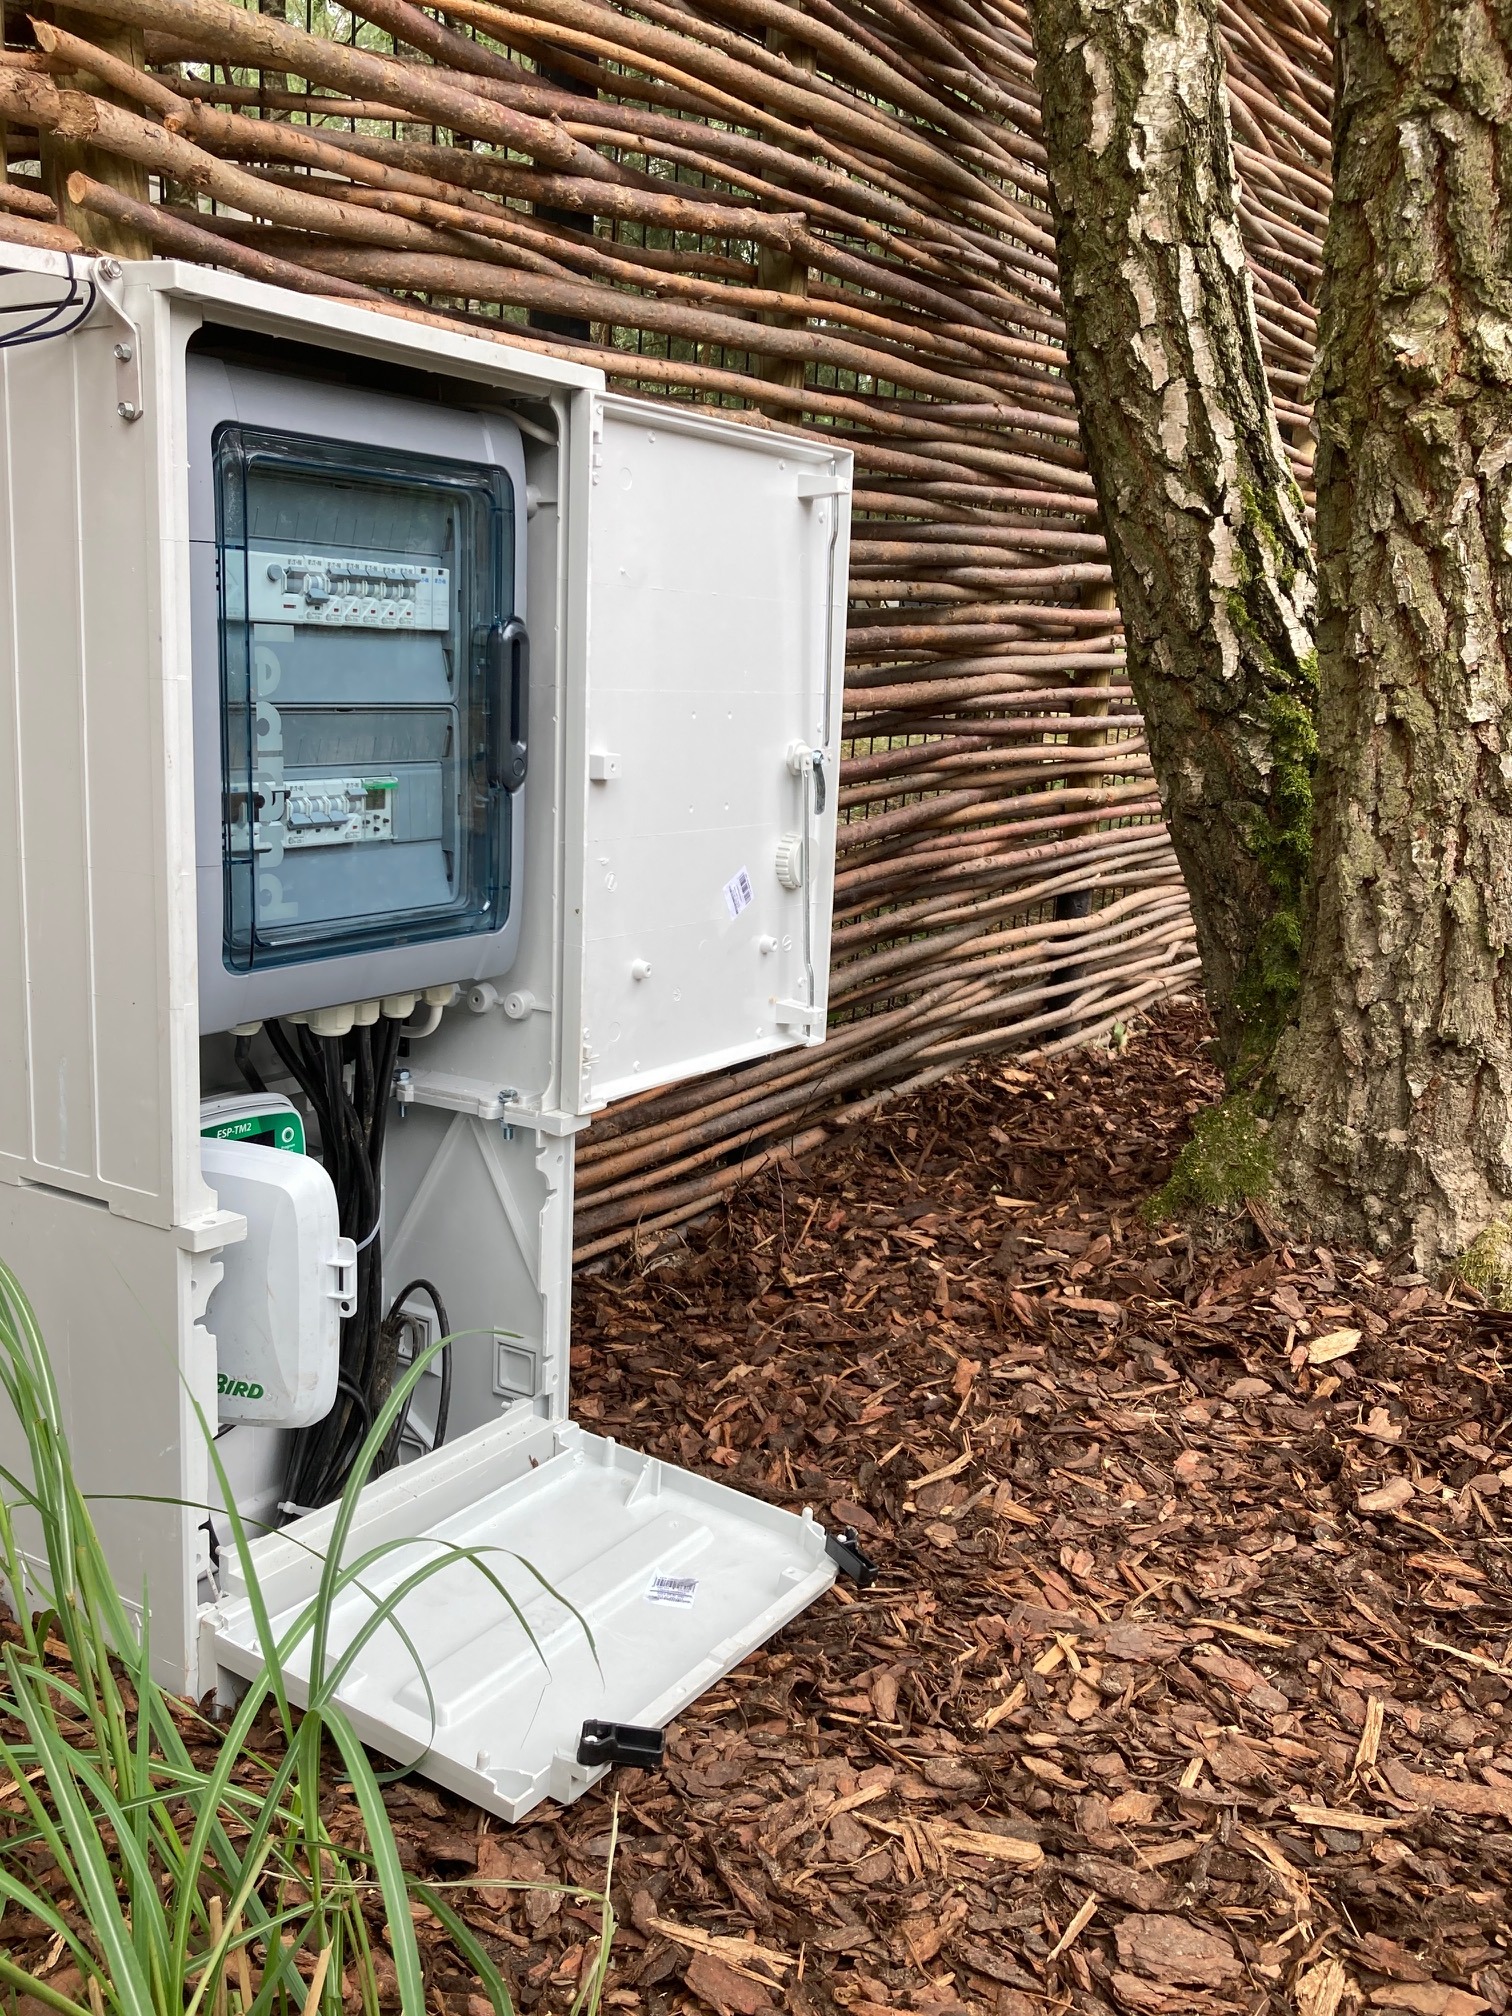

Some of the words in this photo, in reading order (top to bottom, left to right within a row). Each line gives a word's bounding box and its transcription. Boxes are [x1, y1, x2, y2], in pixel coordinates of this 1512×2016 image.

[253, 623, 298, 922] legrand
[217, 1122, 252, 1139] ESP-TM2
[217, 1373, 264, 1399] BIRD
